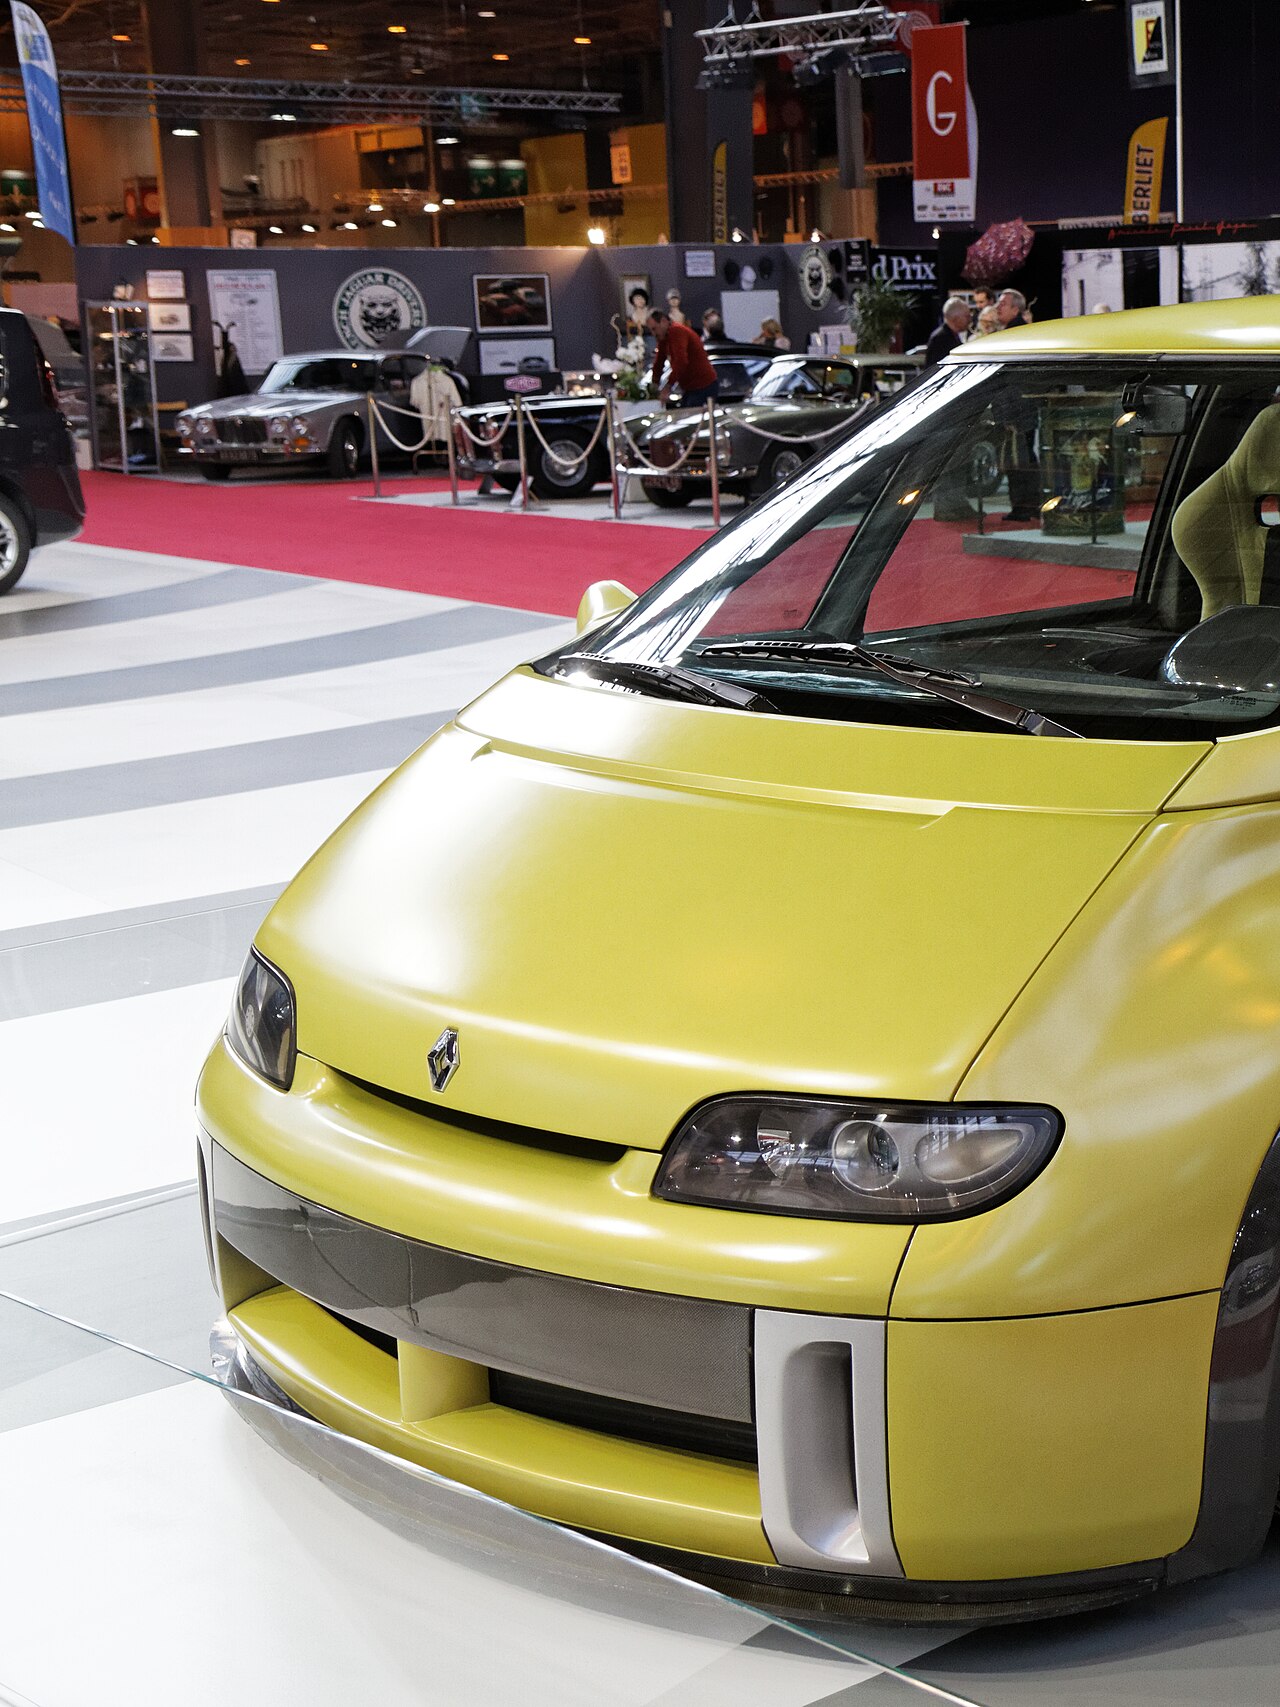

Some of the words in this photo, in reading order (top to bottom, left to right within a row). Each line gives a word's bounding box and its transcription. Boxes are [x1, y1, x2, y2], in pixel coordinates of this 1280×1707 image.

[926, 70, 957, 137] G
[1132, 143, 1154, 225] BERLIET
[890, 254, 937, 280] Prix
